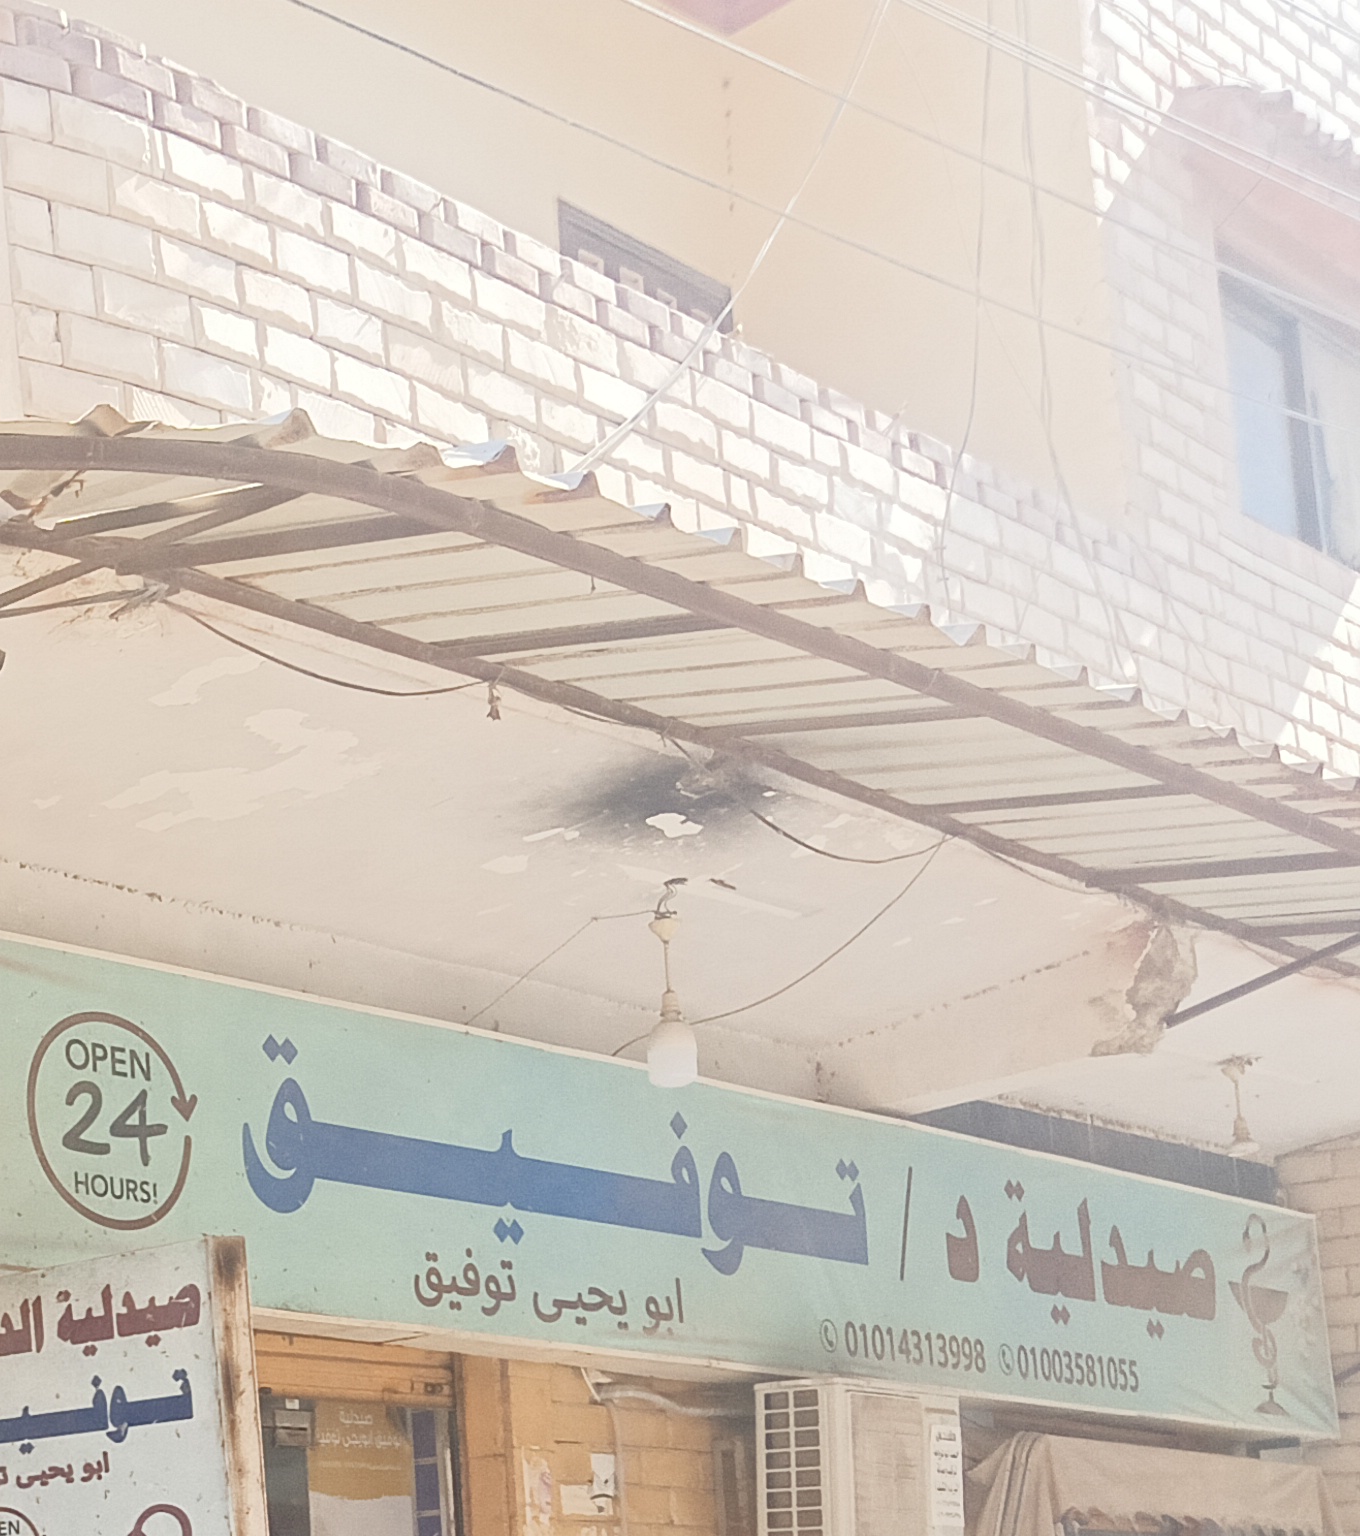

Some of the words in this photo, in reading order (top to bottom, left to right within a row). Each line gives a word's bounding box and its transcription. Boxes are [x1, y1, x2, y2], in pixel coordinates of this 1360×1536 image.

[66, 1038, 152, 1082] OPEN
[62, 1081, 168, 1166] 24
[242, 1034, 869, 1276] توفيق
[74, 1171, 158, 1205] HOURS!
[946, 1195, 979, 1283] د
[1004, 1180, 1216, 1340] صيدلية
[413, 1248, 517, 1317] توفيق
[533, 1284, 628, 1333] يحيى
[644, 1277, 684, 1335] ابو
[57, 1284, 201, 1357] صيدلية
[845, 1320, 987, 1374] 01014313998
[1016, 1344, 1139, 1393] 01003581055
[81, 1450, 109, 1482] ابو
